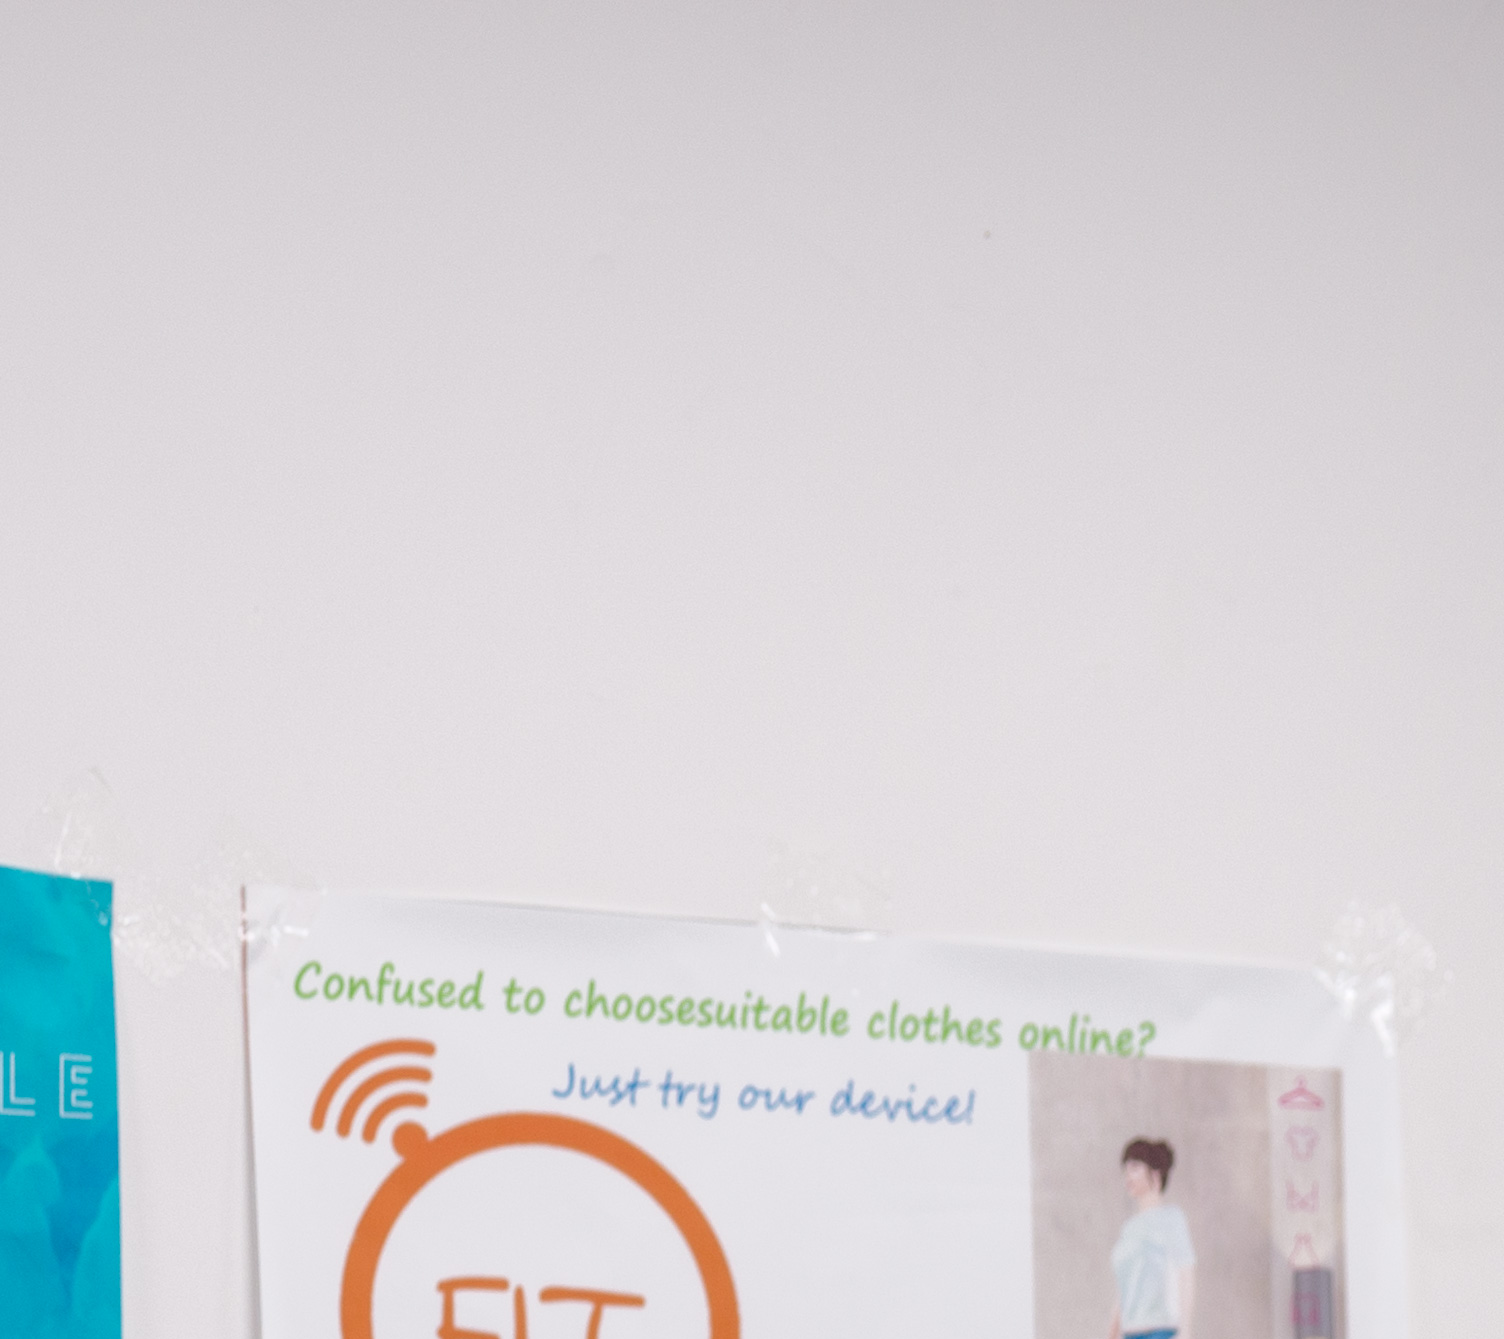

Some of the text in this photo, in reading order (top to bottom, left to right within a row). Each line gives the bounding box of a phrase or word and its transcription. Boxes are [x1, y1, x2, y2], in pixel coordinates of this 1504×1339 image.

[293, 960, 1157, 1059] Confused to choosesuitable clothes online?
[551, 1062, 977, 1125] Just try our device!
